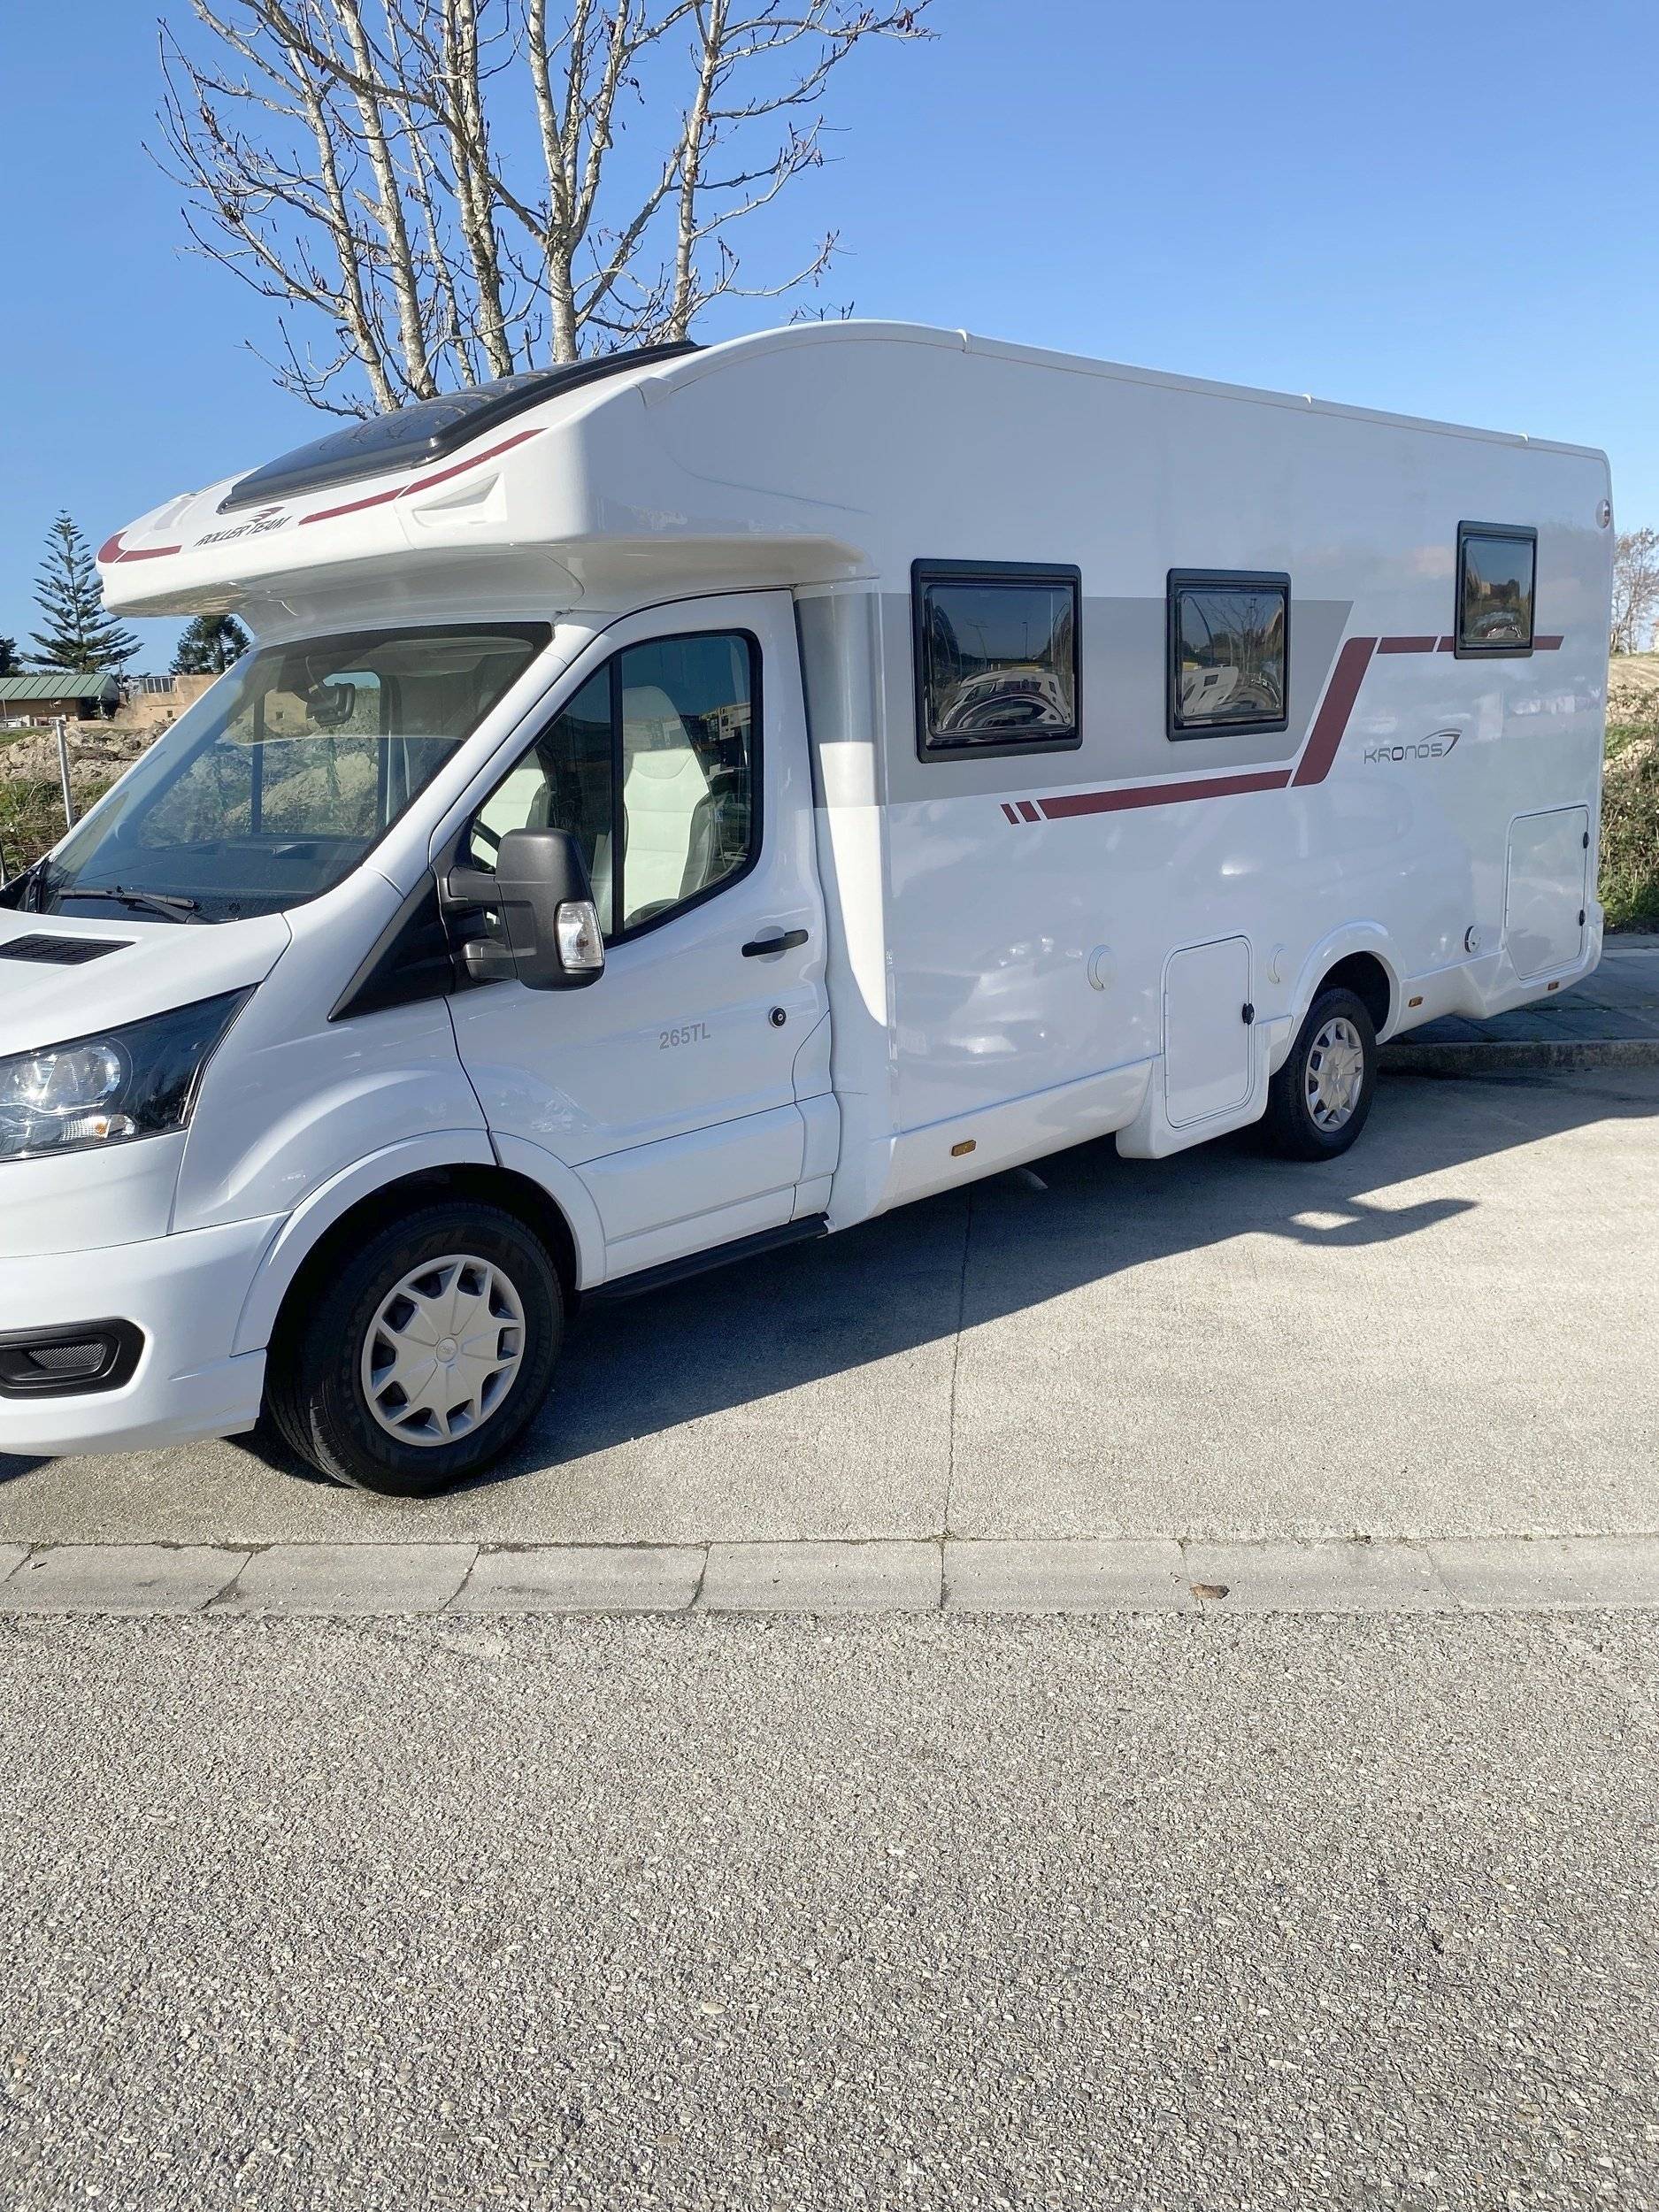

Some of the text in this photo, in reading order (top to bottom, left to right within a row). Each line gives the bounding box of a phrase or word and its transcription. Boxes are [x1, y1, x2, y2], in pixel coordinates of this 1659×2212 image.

[193, 516, 294, 547] ROLLER TEAM
[1363, 743, 1443, 764] KRONOS
[659, 1022, 710, 1050] 265TL
